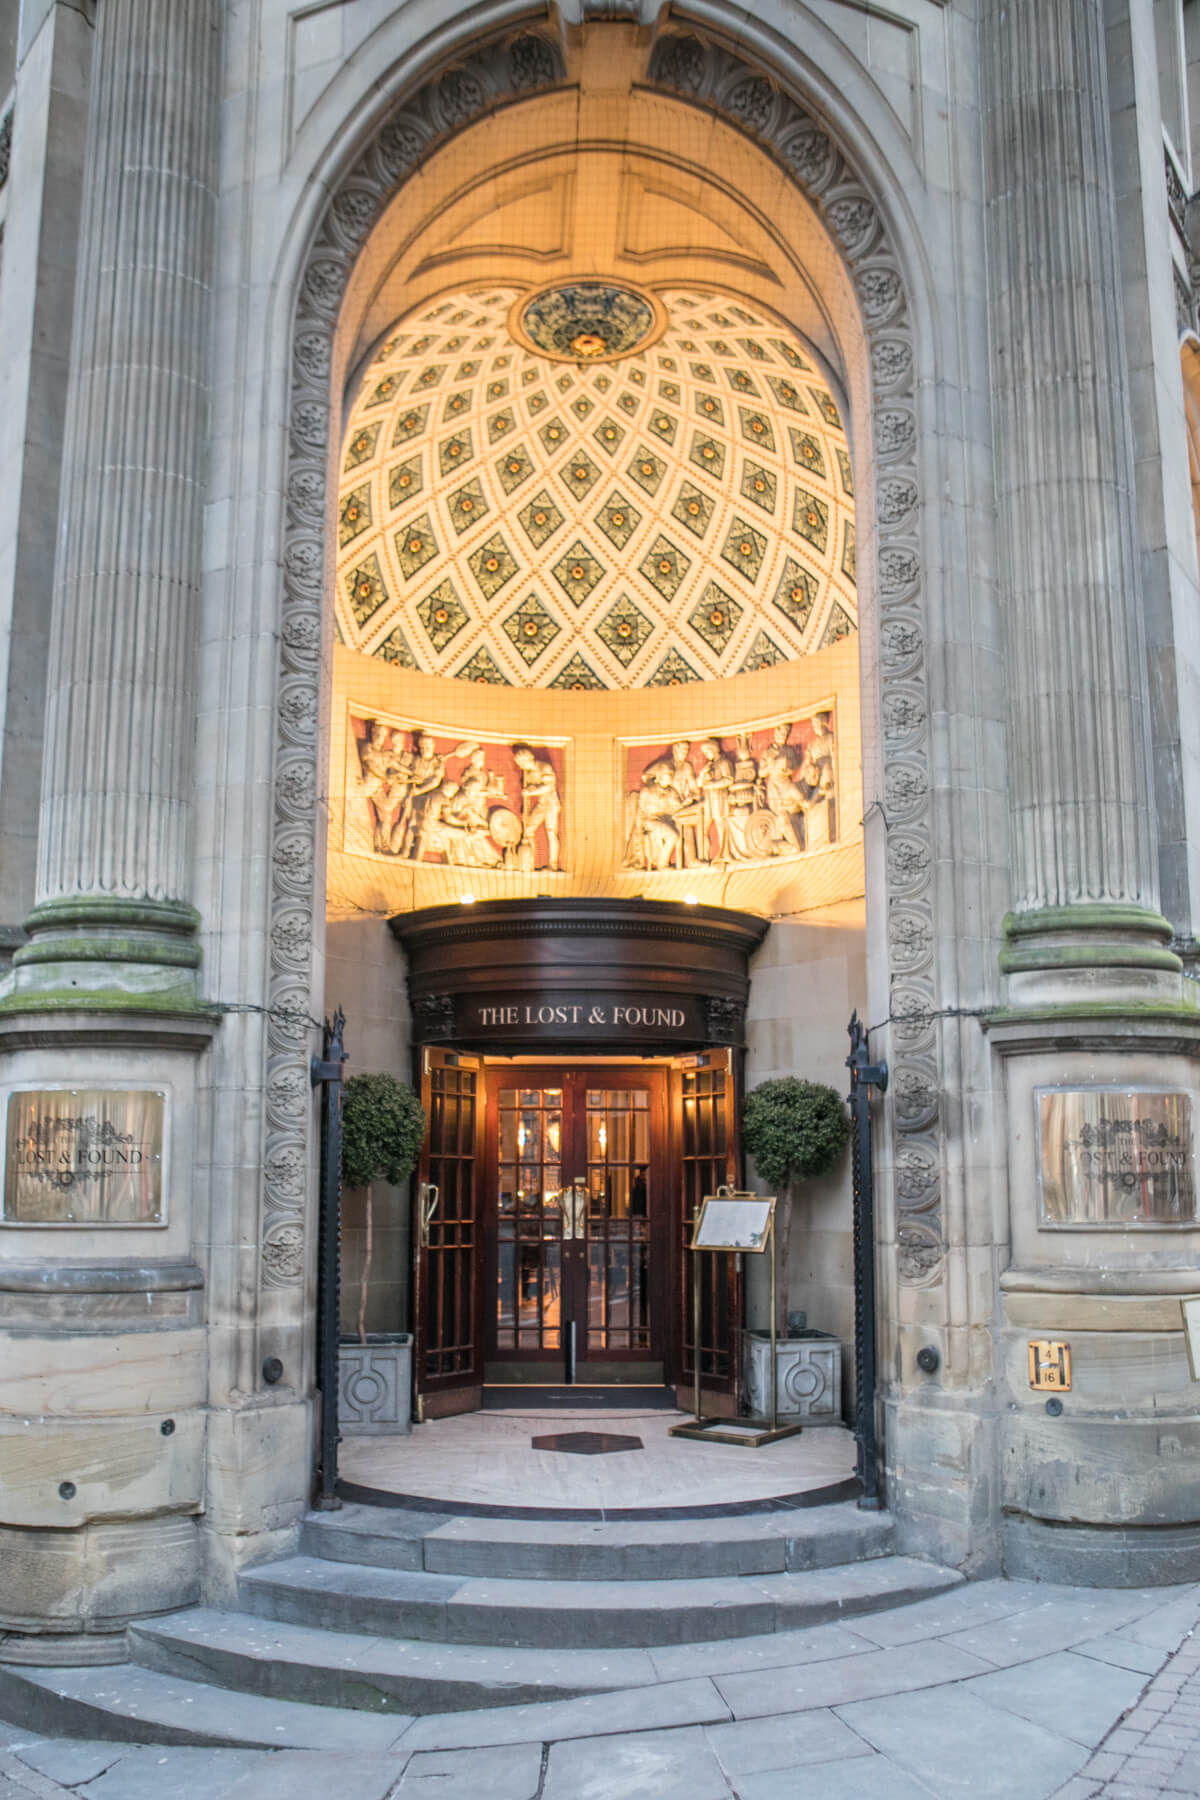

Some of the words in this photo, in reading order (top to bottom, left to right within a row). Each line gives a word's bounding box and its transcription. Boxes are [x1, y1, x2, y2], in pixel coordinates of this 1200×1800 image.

[478, 1007, 519, 1026] THE
[525, 1006, 582, 1025] LOST
[588, 1006, 606, 1025] &
[612, 1007, 686, 1028] FOUND
[16, 1150, 55, 1165] LOST
[58, 1150, 71, 1165] &
[78, 1150, 142, 1165] FOUND
[1068, 1151, 1115, 1166] OST
[1119, 1151, 1133, 1166] &
[1138, 1151, 1186, 1166] FOUND
[1044, 1372, 1056, 1383] 16
